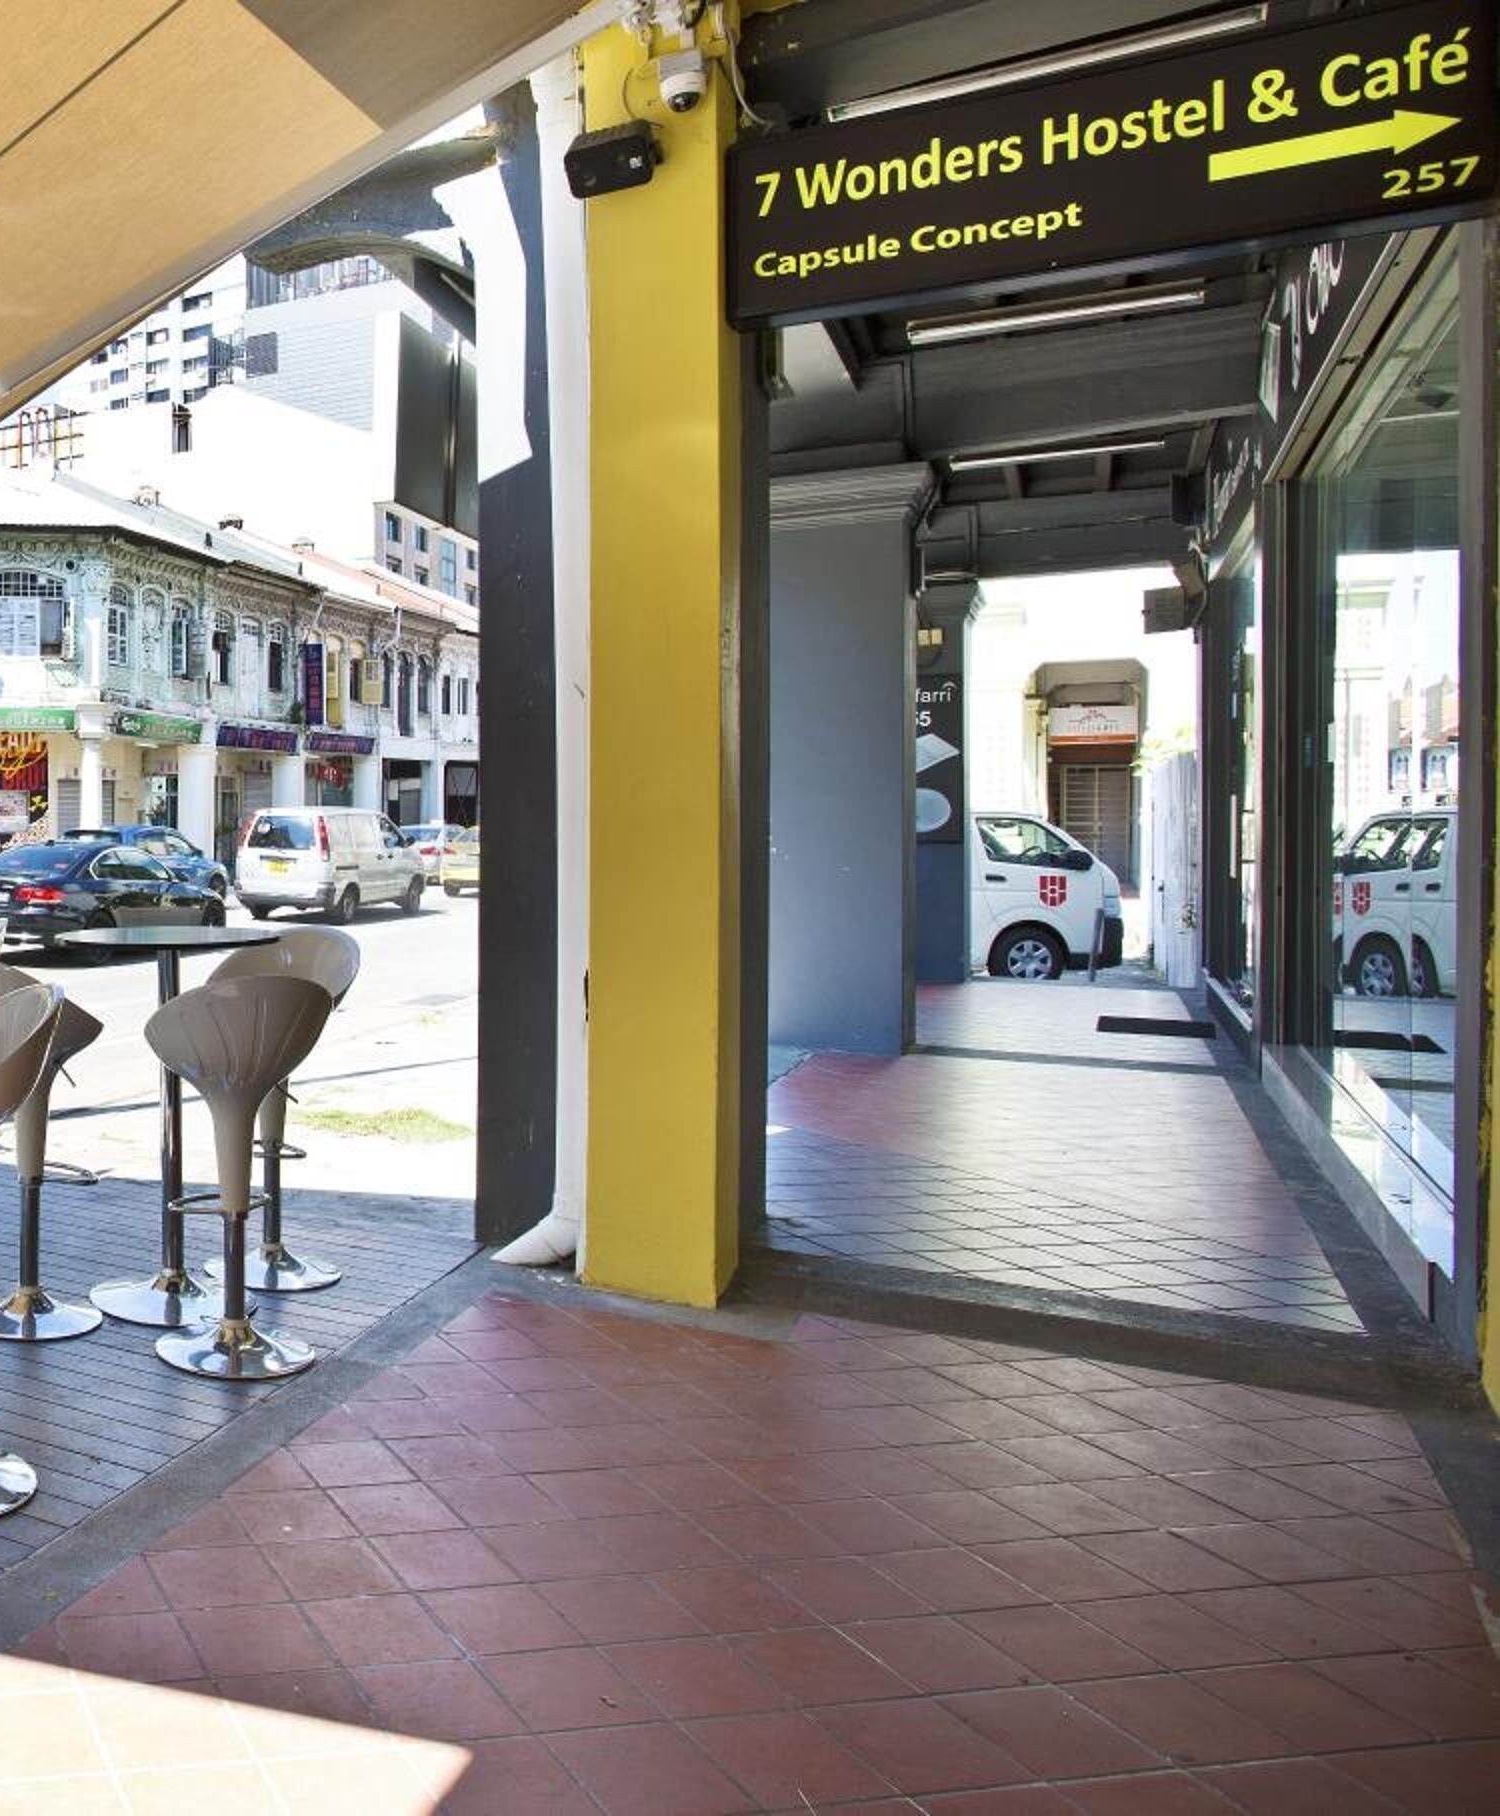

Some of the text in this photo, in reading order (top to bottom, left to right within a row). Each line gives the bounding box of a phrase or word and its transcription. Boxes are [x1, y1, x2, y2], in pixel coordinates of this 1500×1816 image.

[755, 26, 1472, 218] 7 Wonders Hostel & Café
[1381, 155, 1481, 200] 257
[753, 202, 1084, 278] Capsule Concept
